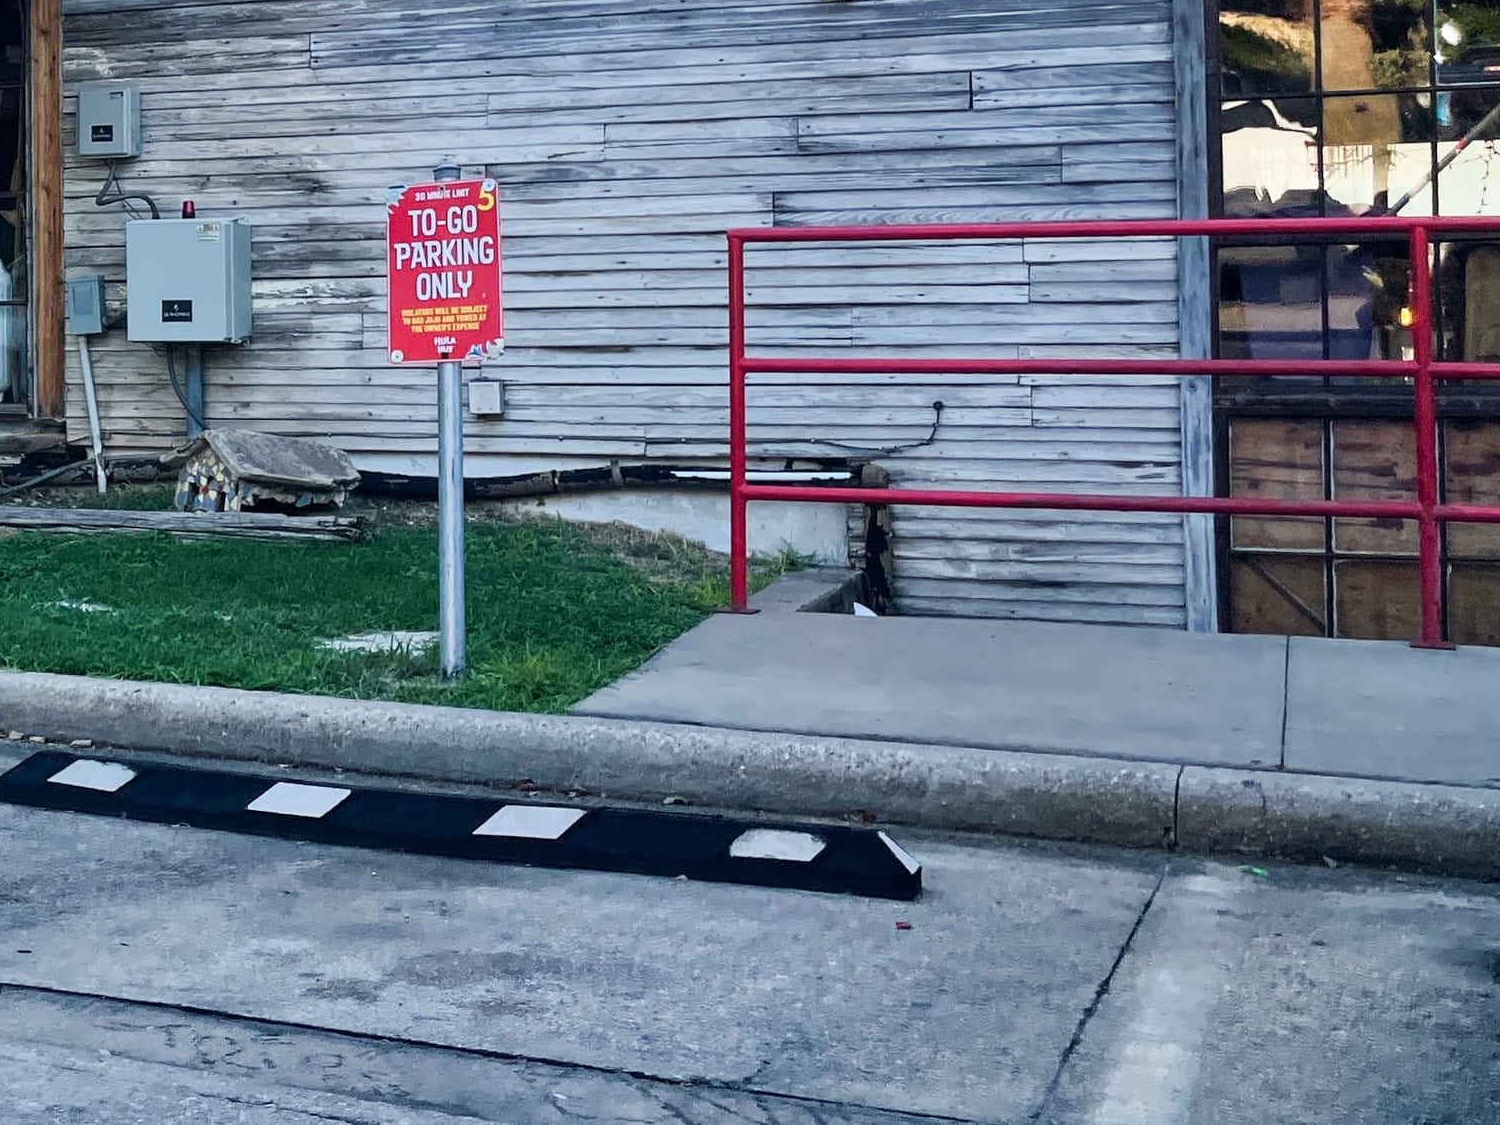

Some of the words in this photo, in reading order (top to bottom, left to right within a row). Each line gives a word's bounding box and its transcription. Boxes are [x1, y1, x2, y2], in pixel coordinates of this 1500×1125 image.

[477, 188, 495, 211] 5
[408, 204, 478, 237] TO-GO
[393, 235, 495, 270] PARKING
[415, 270, 473, 301] ONLY
[434, 336, 456, 346] HULA
